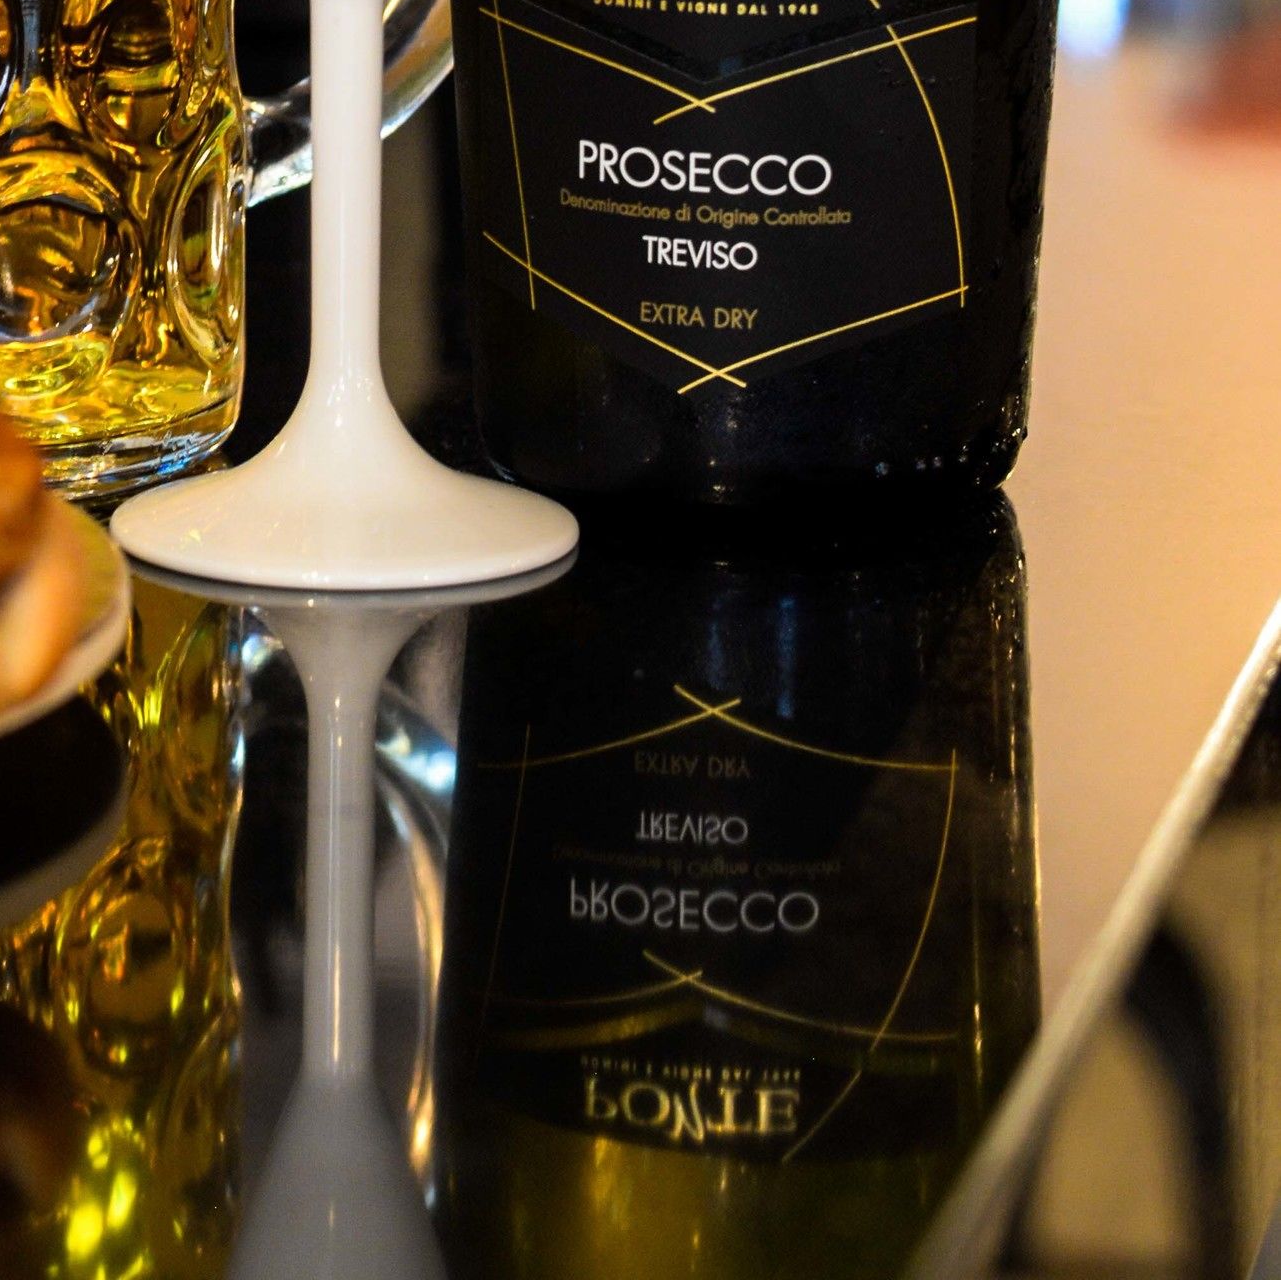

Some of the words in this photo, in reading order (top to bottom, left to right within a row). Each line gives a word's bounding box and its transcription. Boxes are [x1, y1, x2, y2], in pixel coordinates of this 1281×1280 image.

[660, 1, 667, 12] E
[676, 2, 728, 16] VIGNE
[737, 3, 768, 16] DAL
[578, 139, 832, 196] PROSECCO
[560, 189, 670, 221] Denominazione
[675, 203, 691, 222] di
[696, 205, 759, 229] Origine
[764, 207, 852, 226] Controllata
[642, 235, 758, 271] TREVISO
[640, 302, 705, 328] EXTRA
[714, 308, 758, 329] DRY
